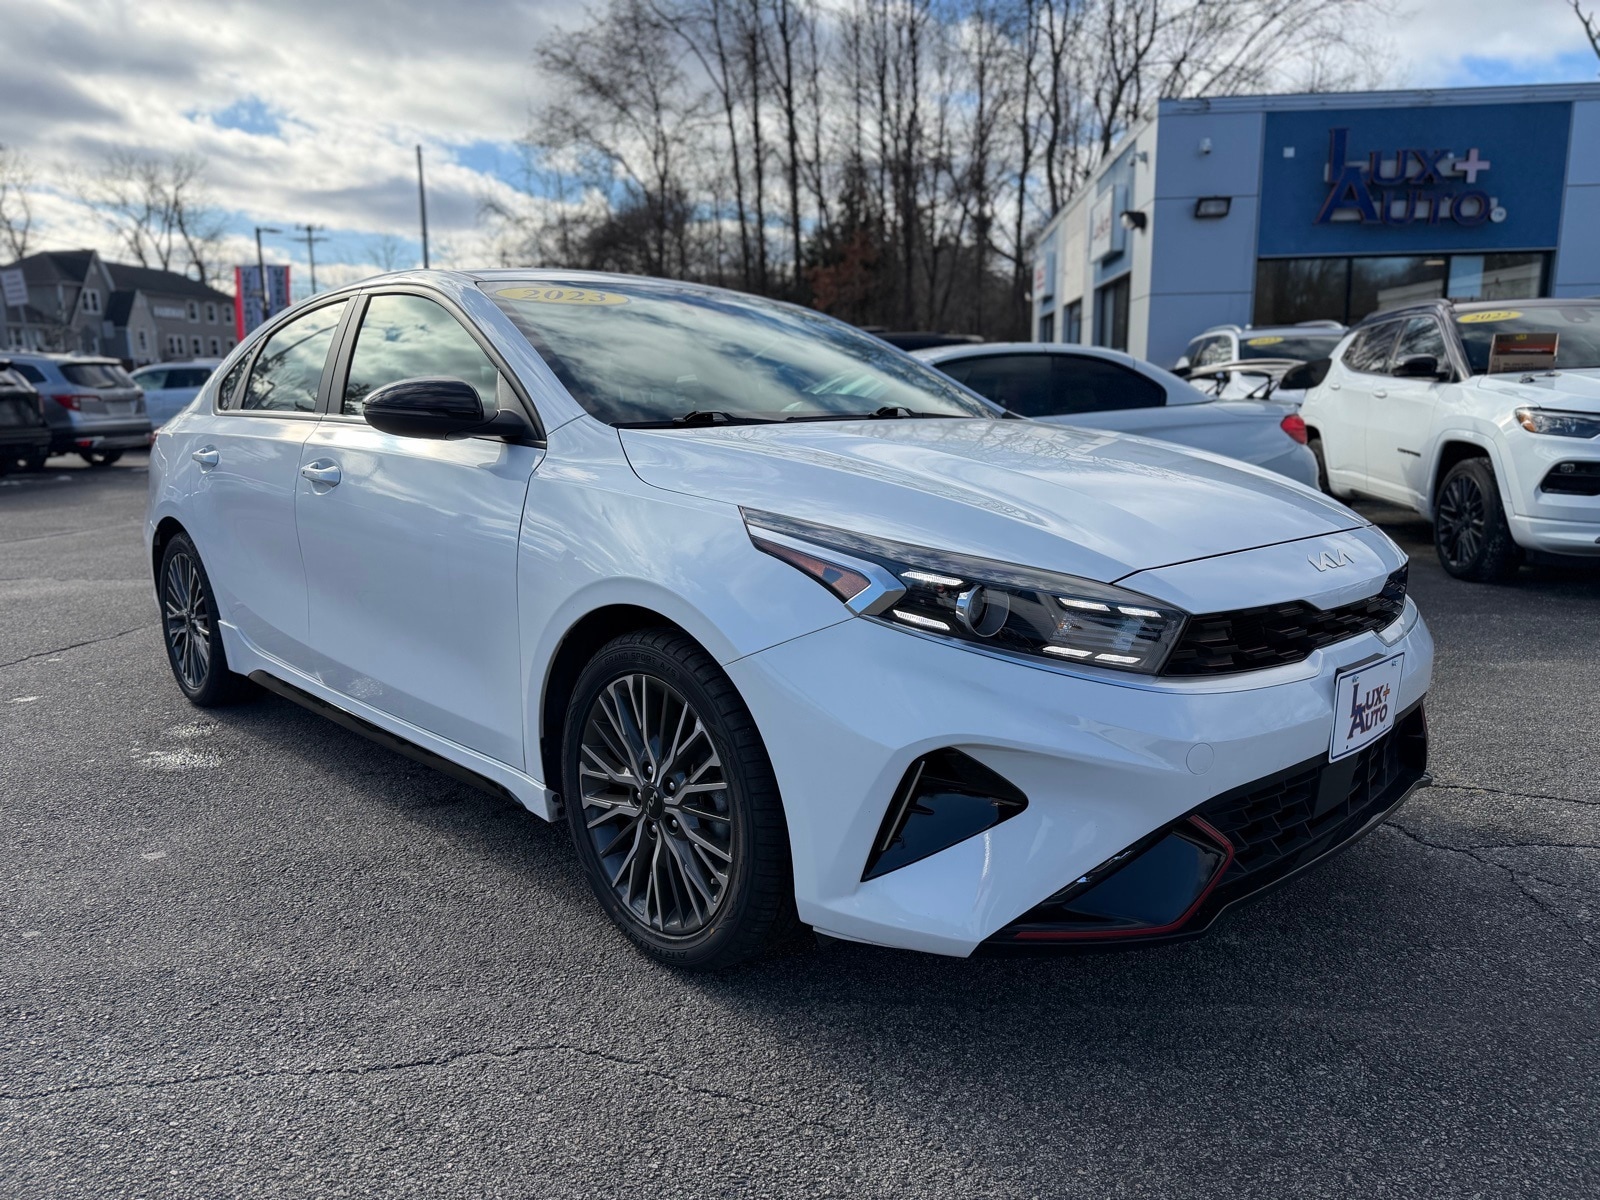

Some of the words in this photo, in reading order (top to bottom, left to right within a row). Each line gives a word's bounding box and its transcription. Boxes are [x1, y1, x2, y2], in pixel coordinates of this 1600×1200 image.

[1313, 167, 1492, 226] AUTO
[522, 289, 606, 302] 2023
[1470, 311, 1512, 321] 2022
[1307, 549, 1354, 572] KIA
[604, 652, 629, 665] GRAND
[631, 652, 657, 664] SPORT
[1347, 703, 1388, 740] AUTO
